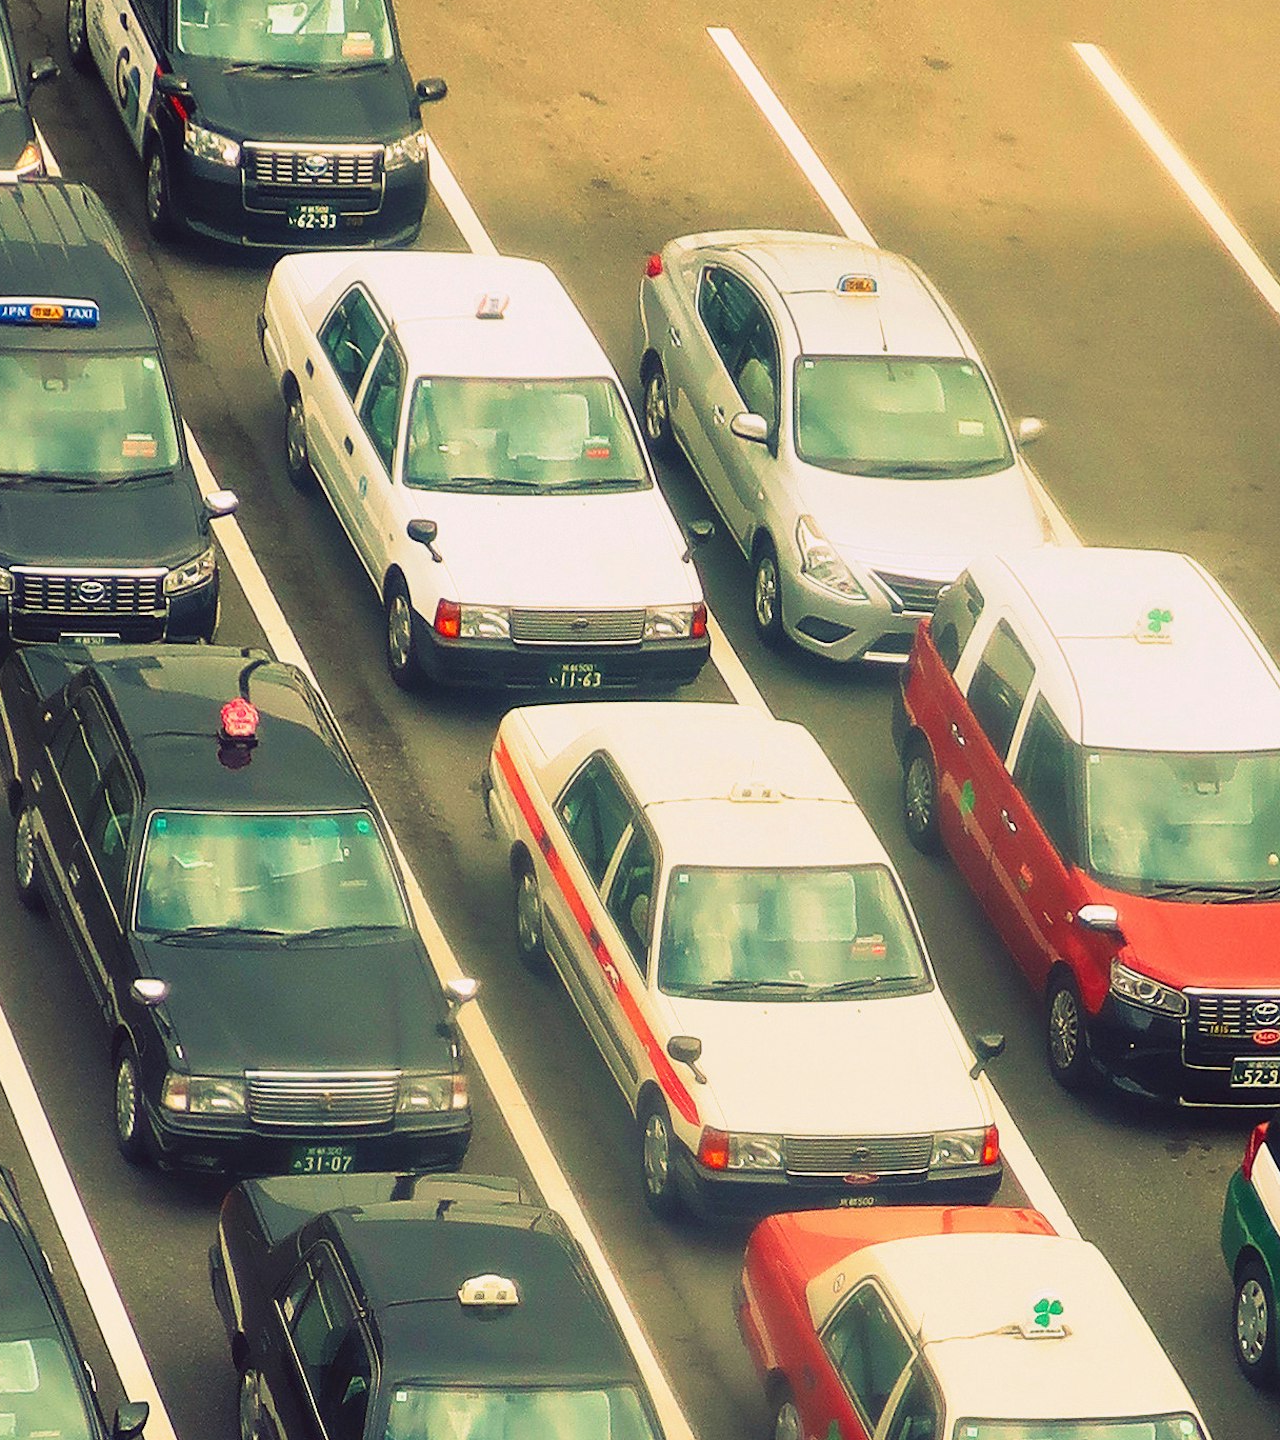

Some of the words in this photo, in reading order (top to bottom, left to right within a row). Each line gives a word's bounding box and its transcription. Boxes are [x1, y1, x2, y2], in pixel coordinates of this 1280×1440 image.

[297, 213, 337, 229] 62-93
[1, 306, 27, 317] JPN
[65, 307, 93, 318] TAXI
[560, 671, 602, 688] 11-63
[304, 1155, 352, 1172] 31-07
